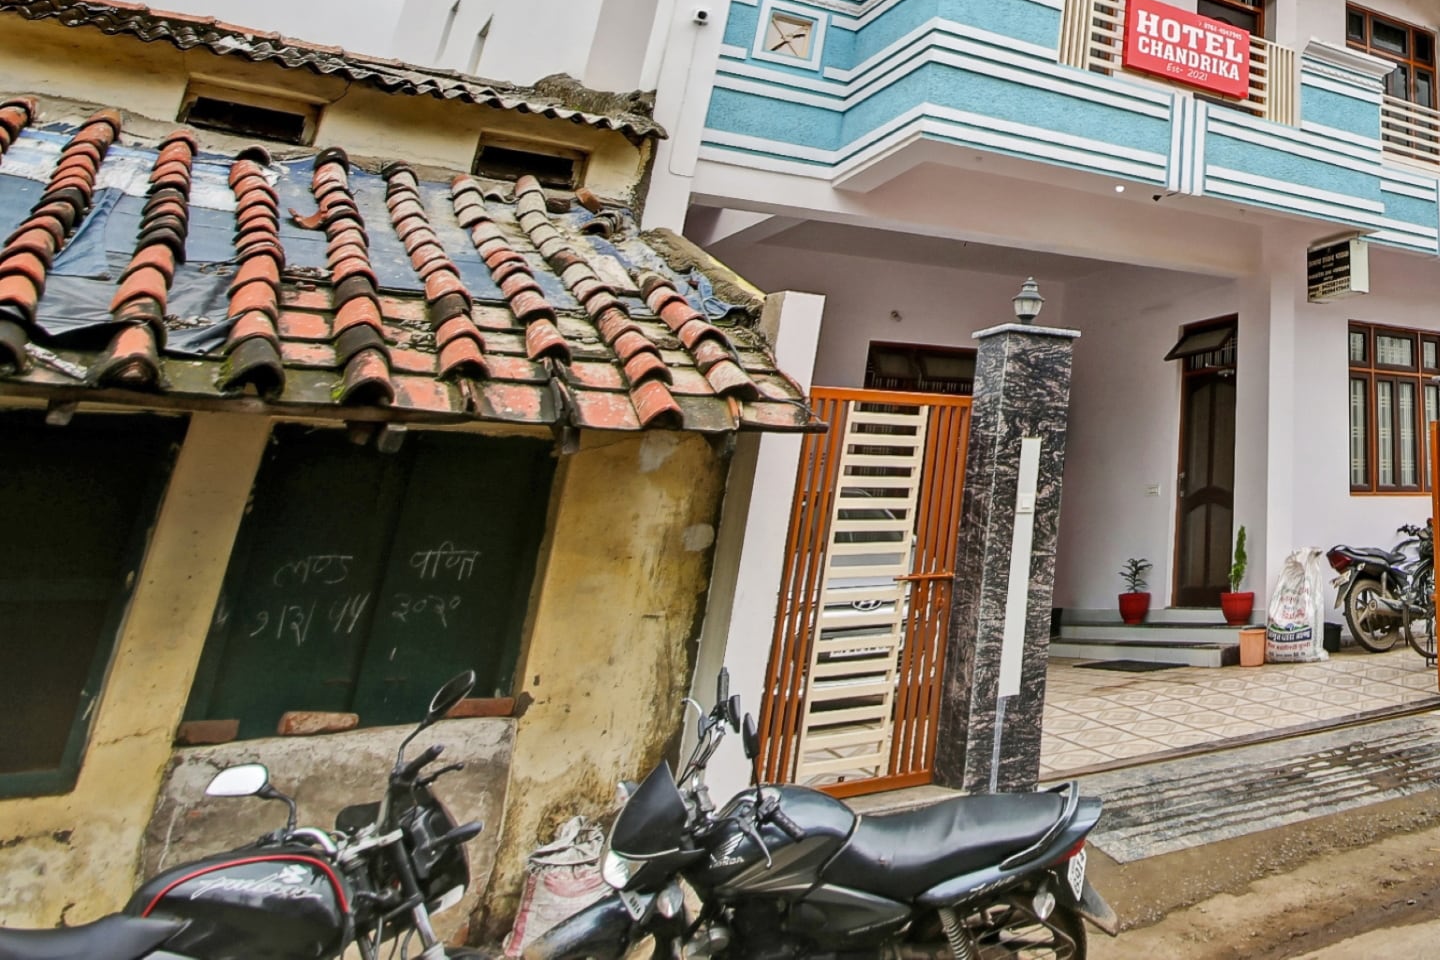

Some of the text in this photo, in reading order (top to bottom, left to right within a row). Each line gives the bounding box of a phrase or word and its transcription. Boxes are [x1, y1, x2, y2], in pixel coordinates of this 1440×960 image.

[1137, 10, 1243, 63] HOTEL
[1138, 36, 1240, 81] CHANDRIKA
[1187, 68, 1208, 81] 2021
